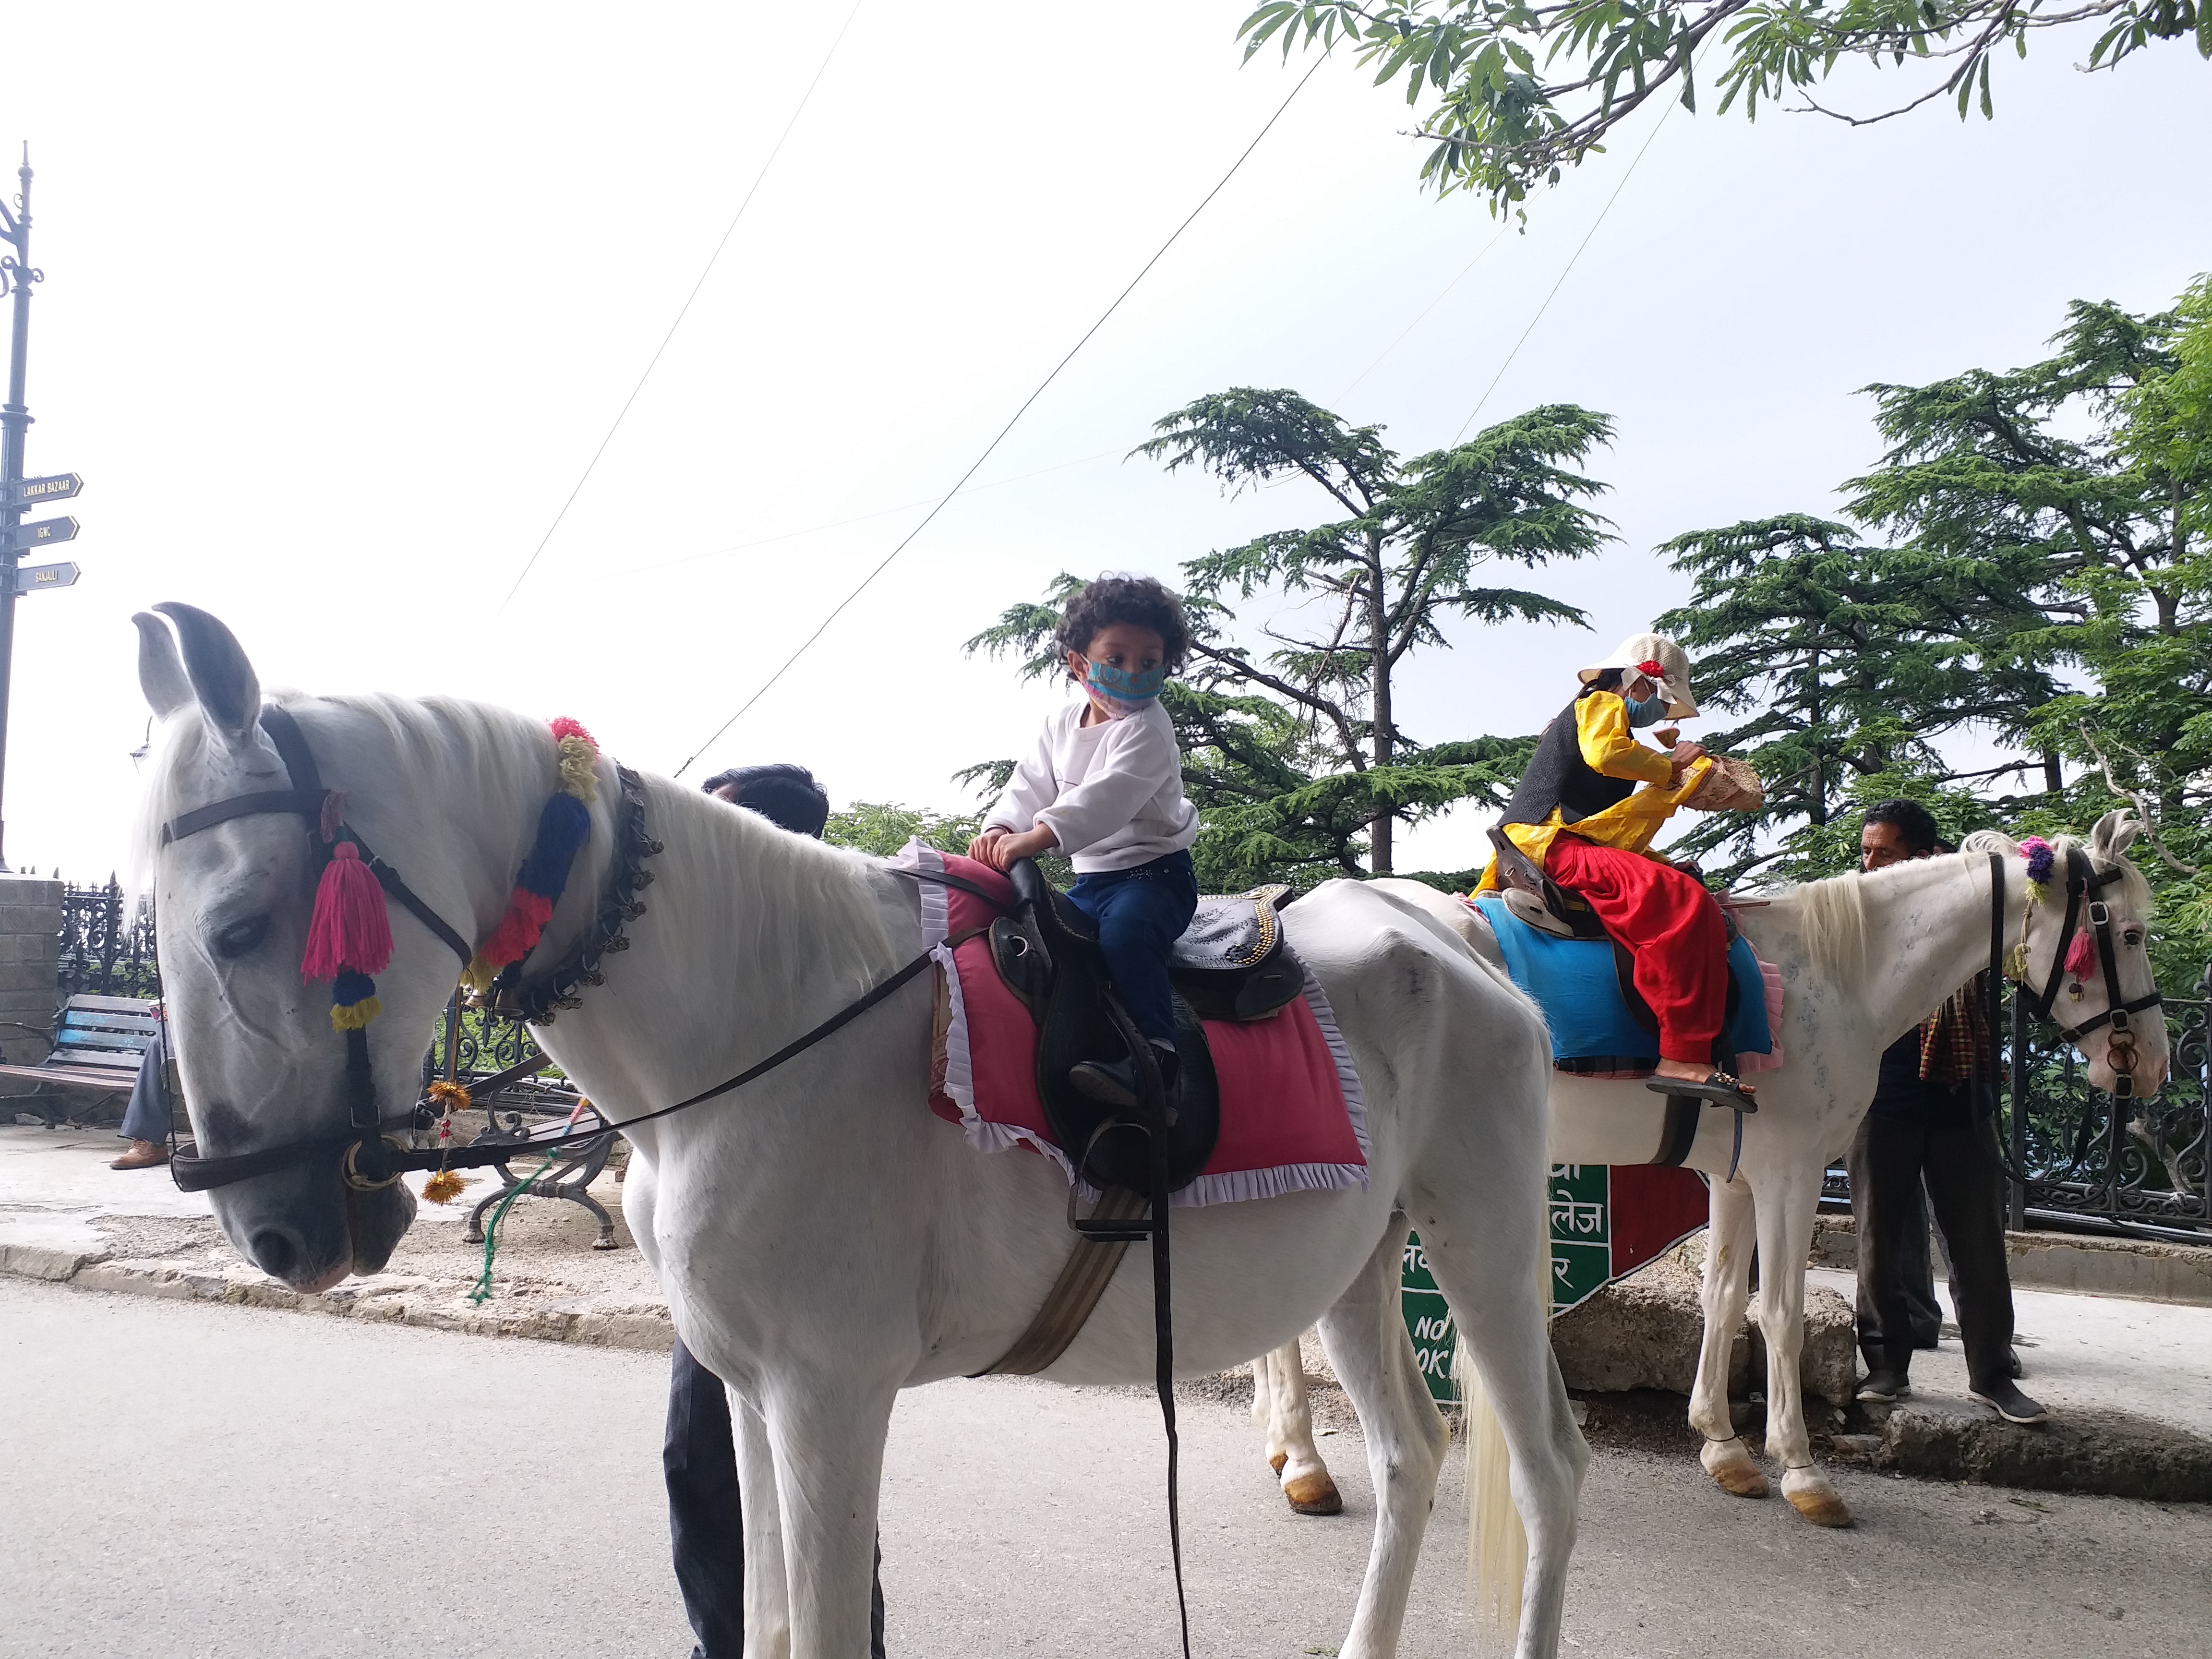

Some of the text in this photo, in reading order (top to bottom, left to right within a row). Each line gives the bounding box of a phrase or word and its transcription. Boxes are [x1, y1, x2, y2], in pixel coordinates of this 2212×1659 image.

[24, 480, 70, 497] LAKKAR BAZAAR
[1548, 1189, 1605, 1235] लेज
